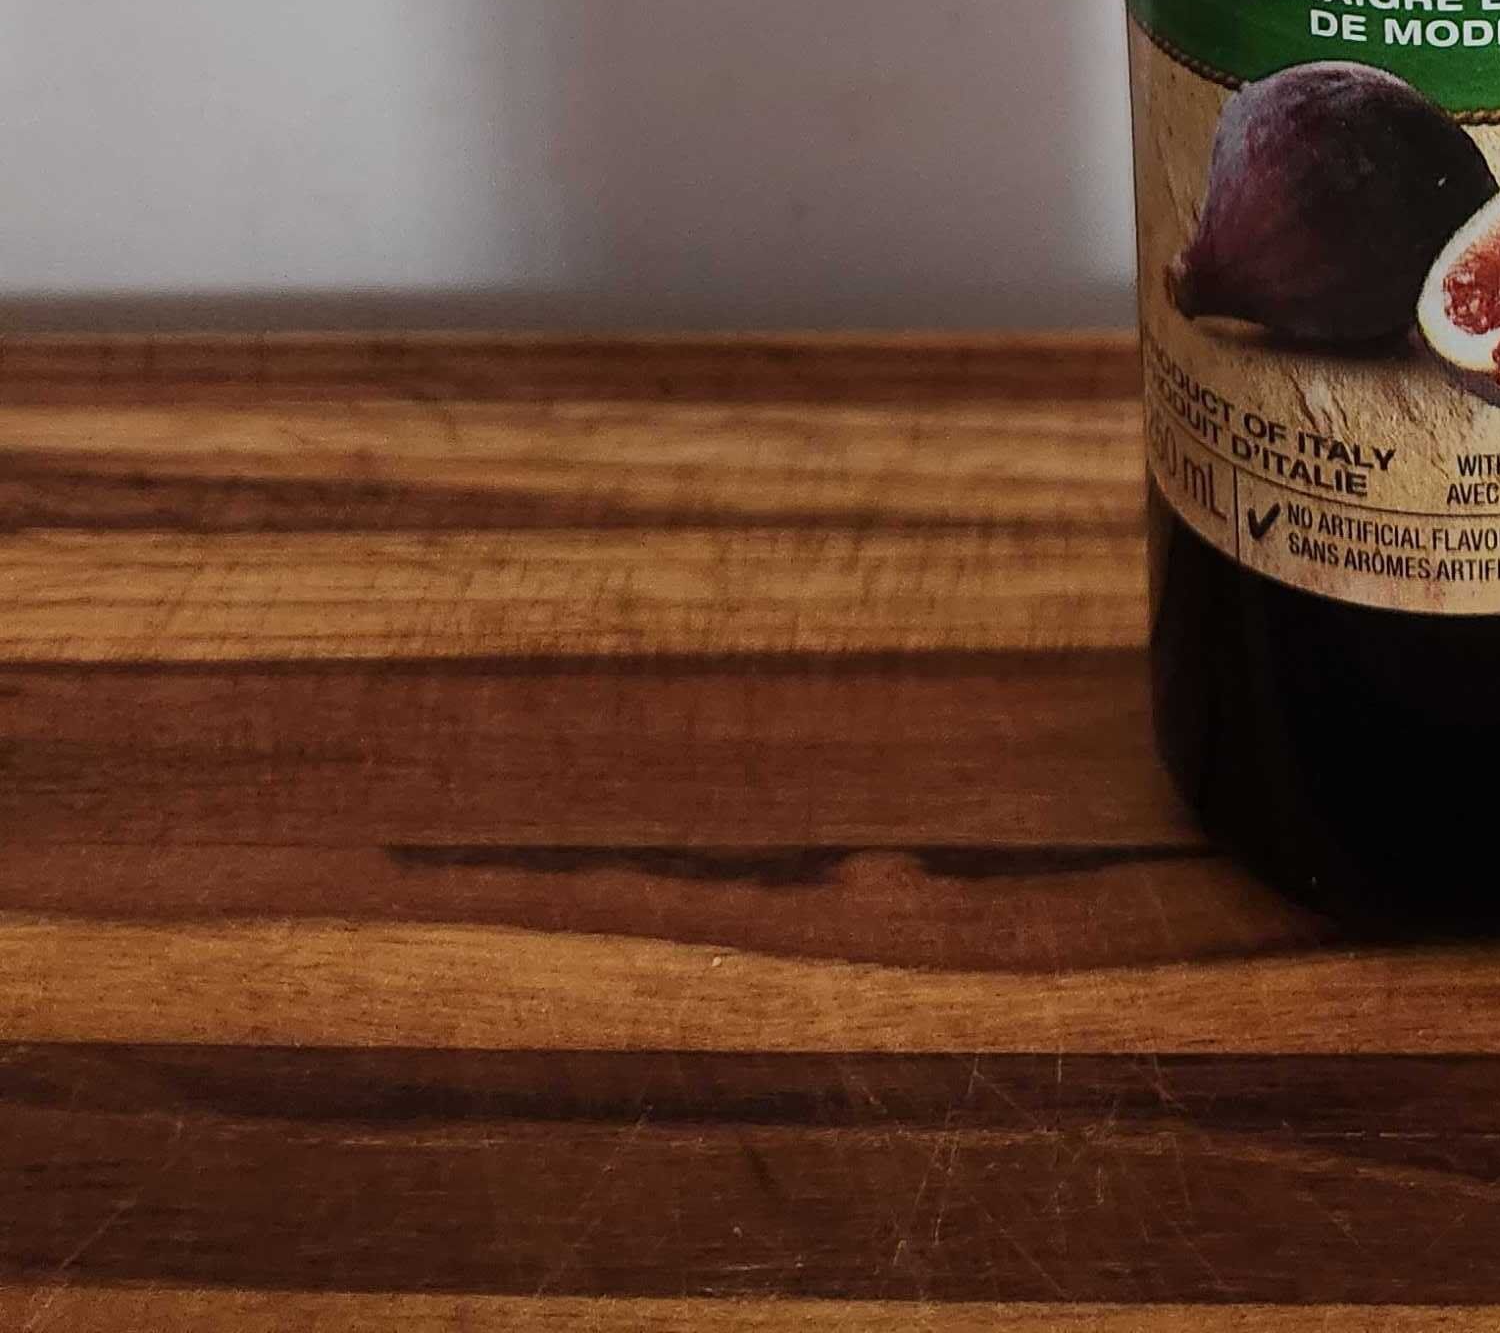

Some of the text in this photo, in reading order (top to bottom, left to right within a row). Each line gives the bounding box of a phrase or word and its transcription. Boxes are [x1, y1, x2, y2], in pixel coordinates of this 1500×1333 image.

[1310, 9, 1368, 42] DE
[1149, 336, 1396, 471] ODUCT OF ITALY
[1446, 481, 1500, 506] AVEC
[1287, 501, 1313, 530] NO
[1318, 511, 1426, 551] ARTIFICIAL
[1288, 533, 1339, 567] SANS
[1344, 545, 1432, 580] ARÔMES
